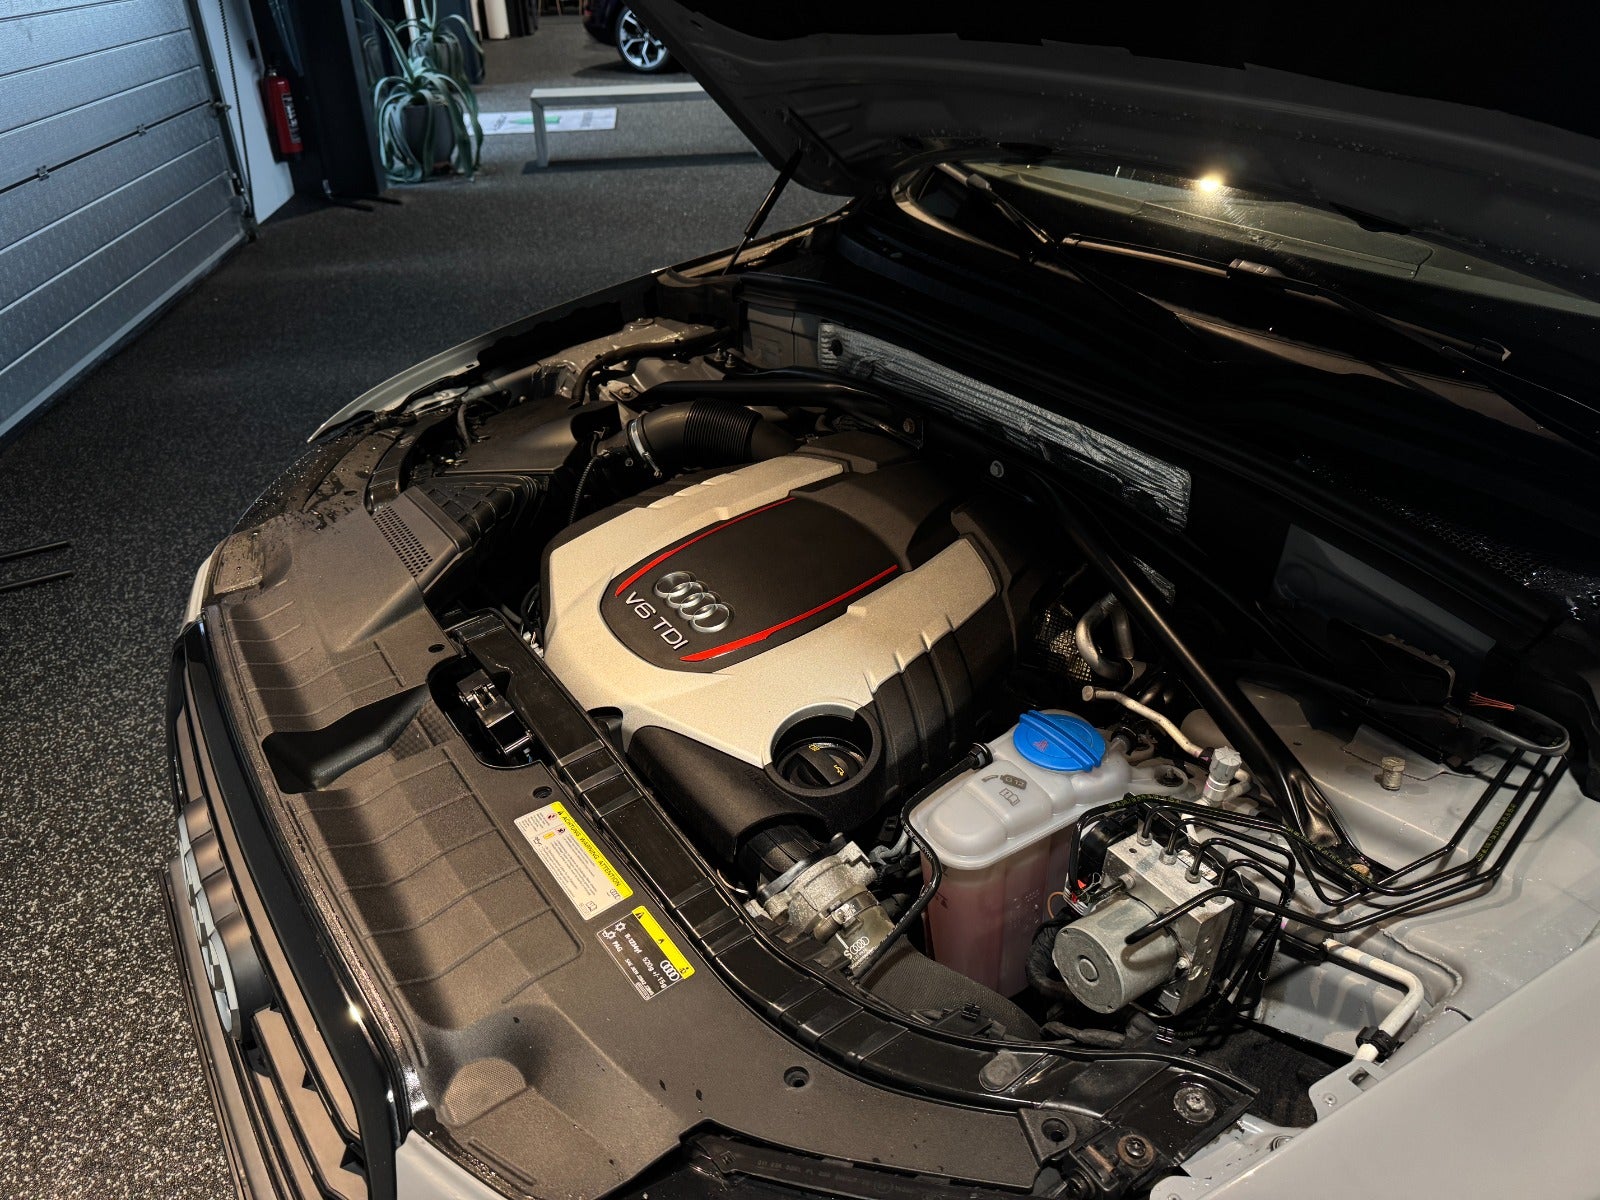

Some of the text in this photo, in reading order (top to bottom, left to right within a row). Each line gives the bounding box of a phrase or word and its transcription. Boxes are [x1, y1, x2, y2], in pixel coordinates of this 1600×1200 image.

[625, 591, 689, 650] V6 TDI
[562, 816, 581, 837] ACHTUNG
[580, 838, 600, 860] WARNING
[598, 860, 621, 887] ATTENTION
[612, 940, 623, 952] PAG
